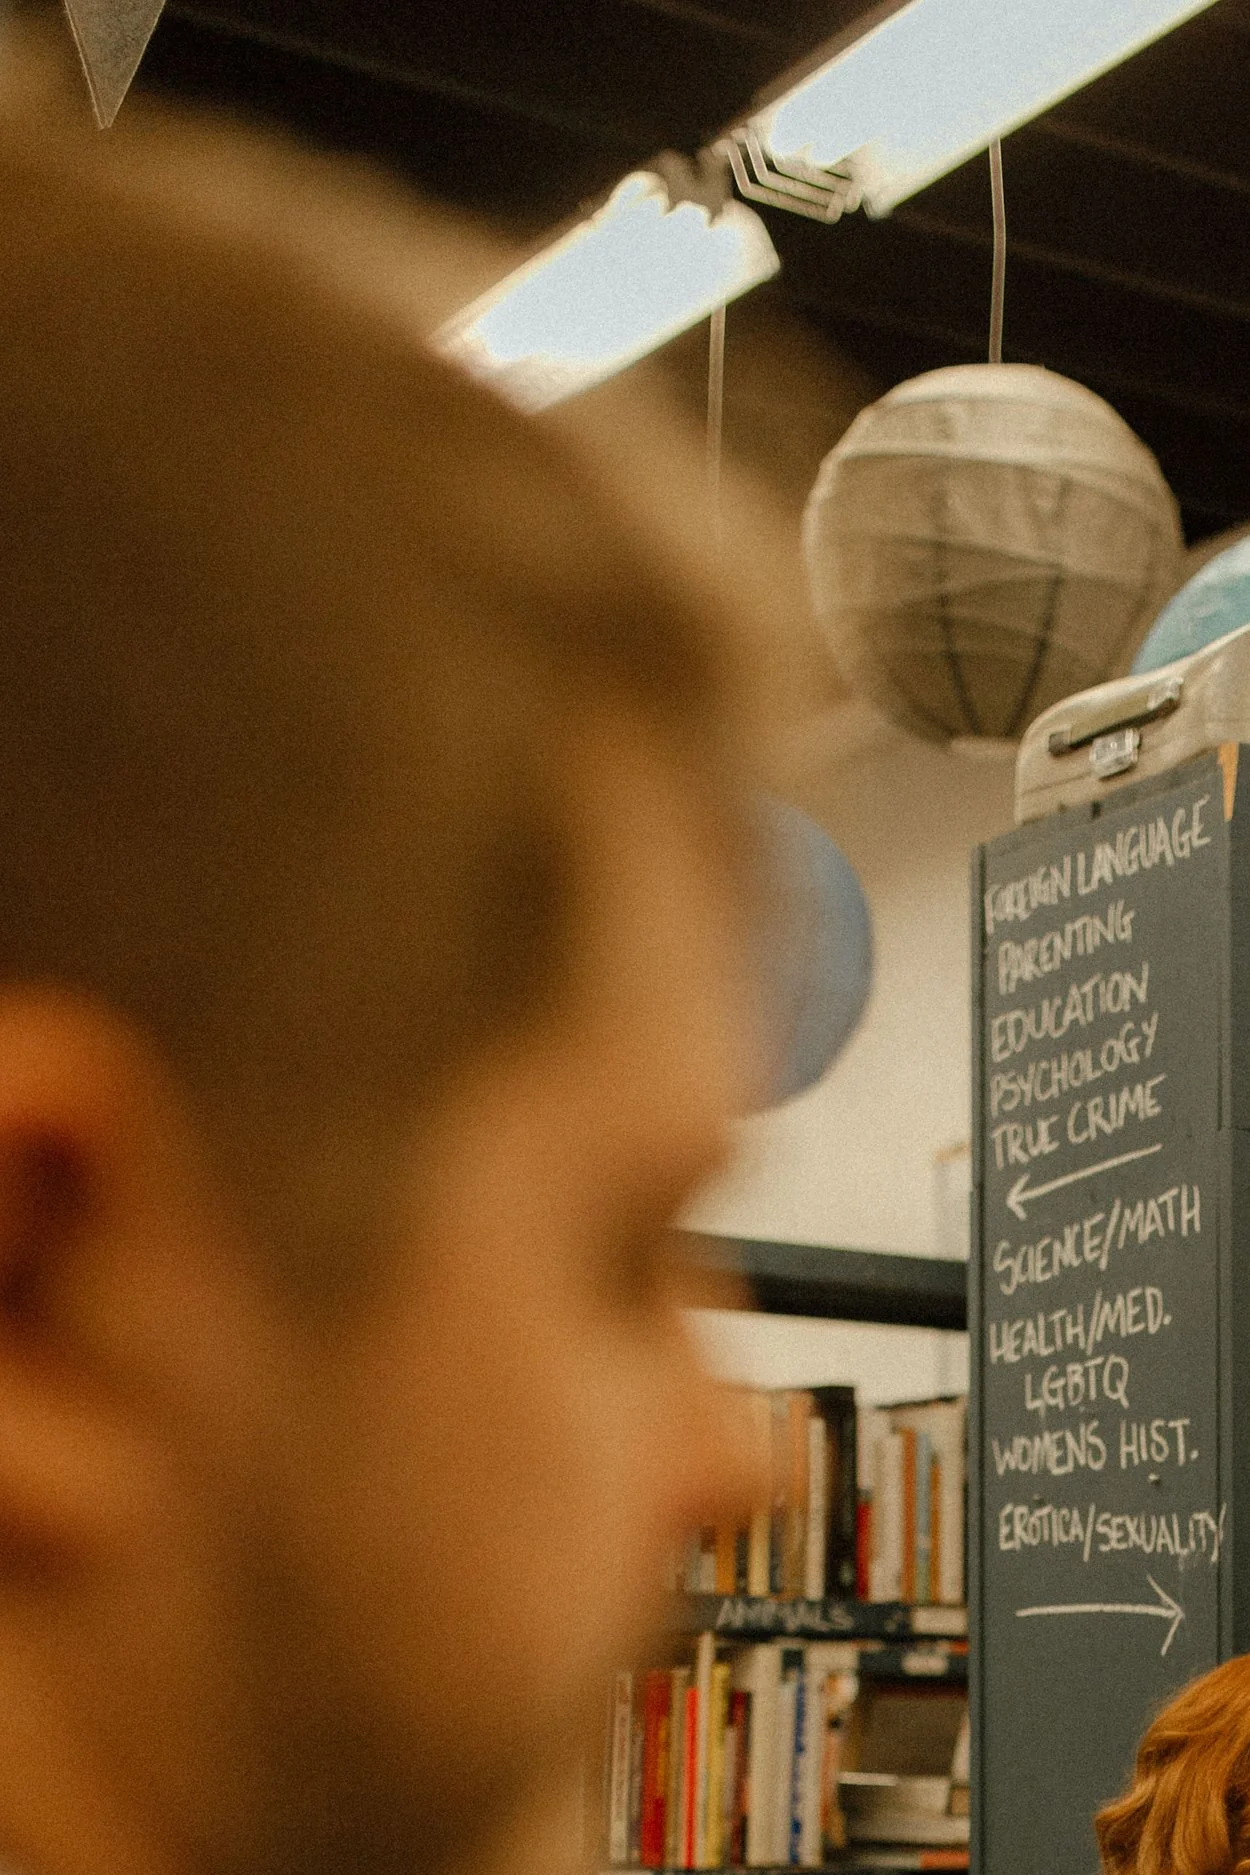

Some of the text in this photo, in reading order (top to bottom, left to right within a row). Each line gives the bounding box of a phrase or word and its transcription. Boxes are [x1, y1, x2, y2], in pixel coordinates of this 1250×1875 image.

[984, 793, 1212, 934] FOREIGN LANGUAGE
[997, 899, 1135, 995] PARENTING
[990, 960, 1150, 1064] EDUCATION
[989, 1010, 1160, 1119] PSYCHOLOGY
[991, 1072, 1168, 1170] TRUE CRIME
[992, 1184, 1202, 1296] SCIENCE/MATH
[989, 1285, 1173, 1365] HEALTH/MED.
[1025, 1355, 1130, 1411] LGBTQ
[992, 1417, 1199, 1476] WOMENS HIST.
[998, 1502, 1228, 1563] EROTICA/SEXUALITY
